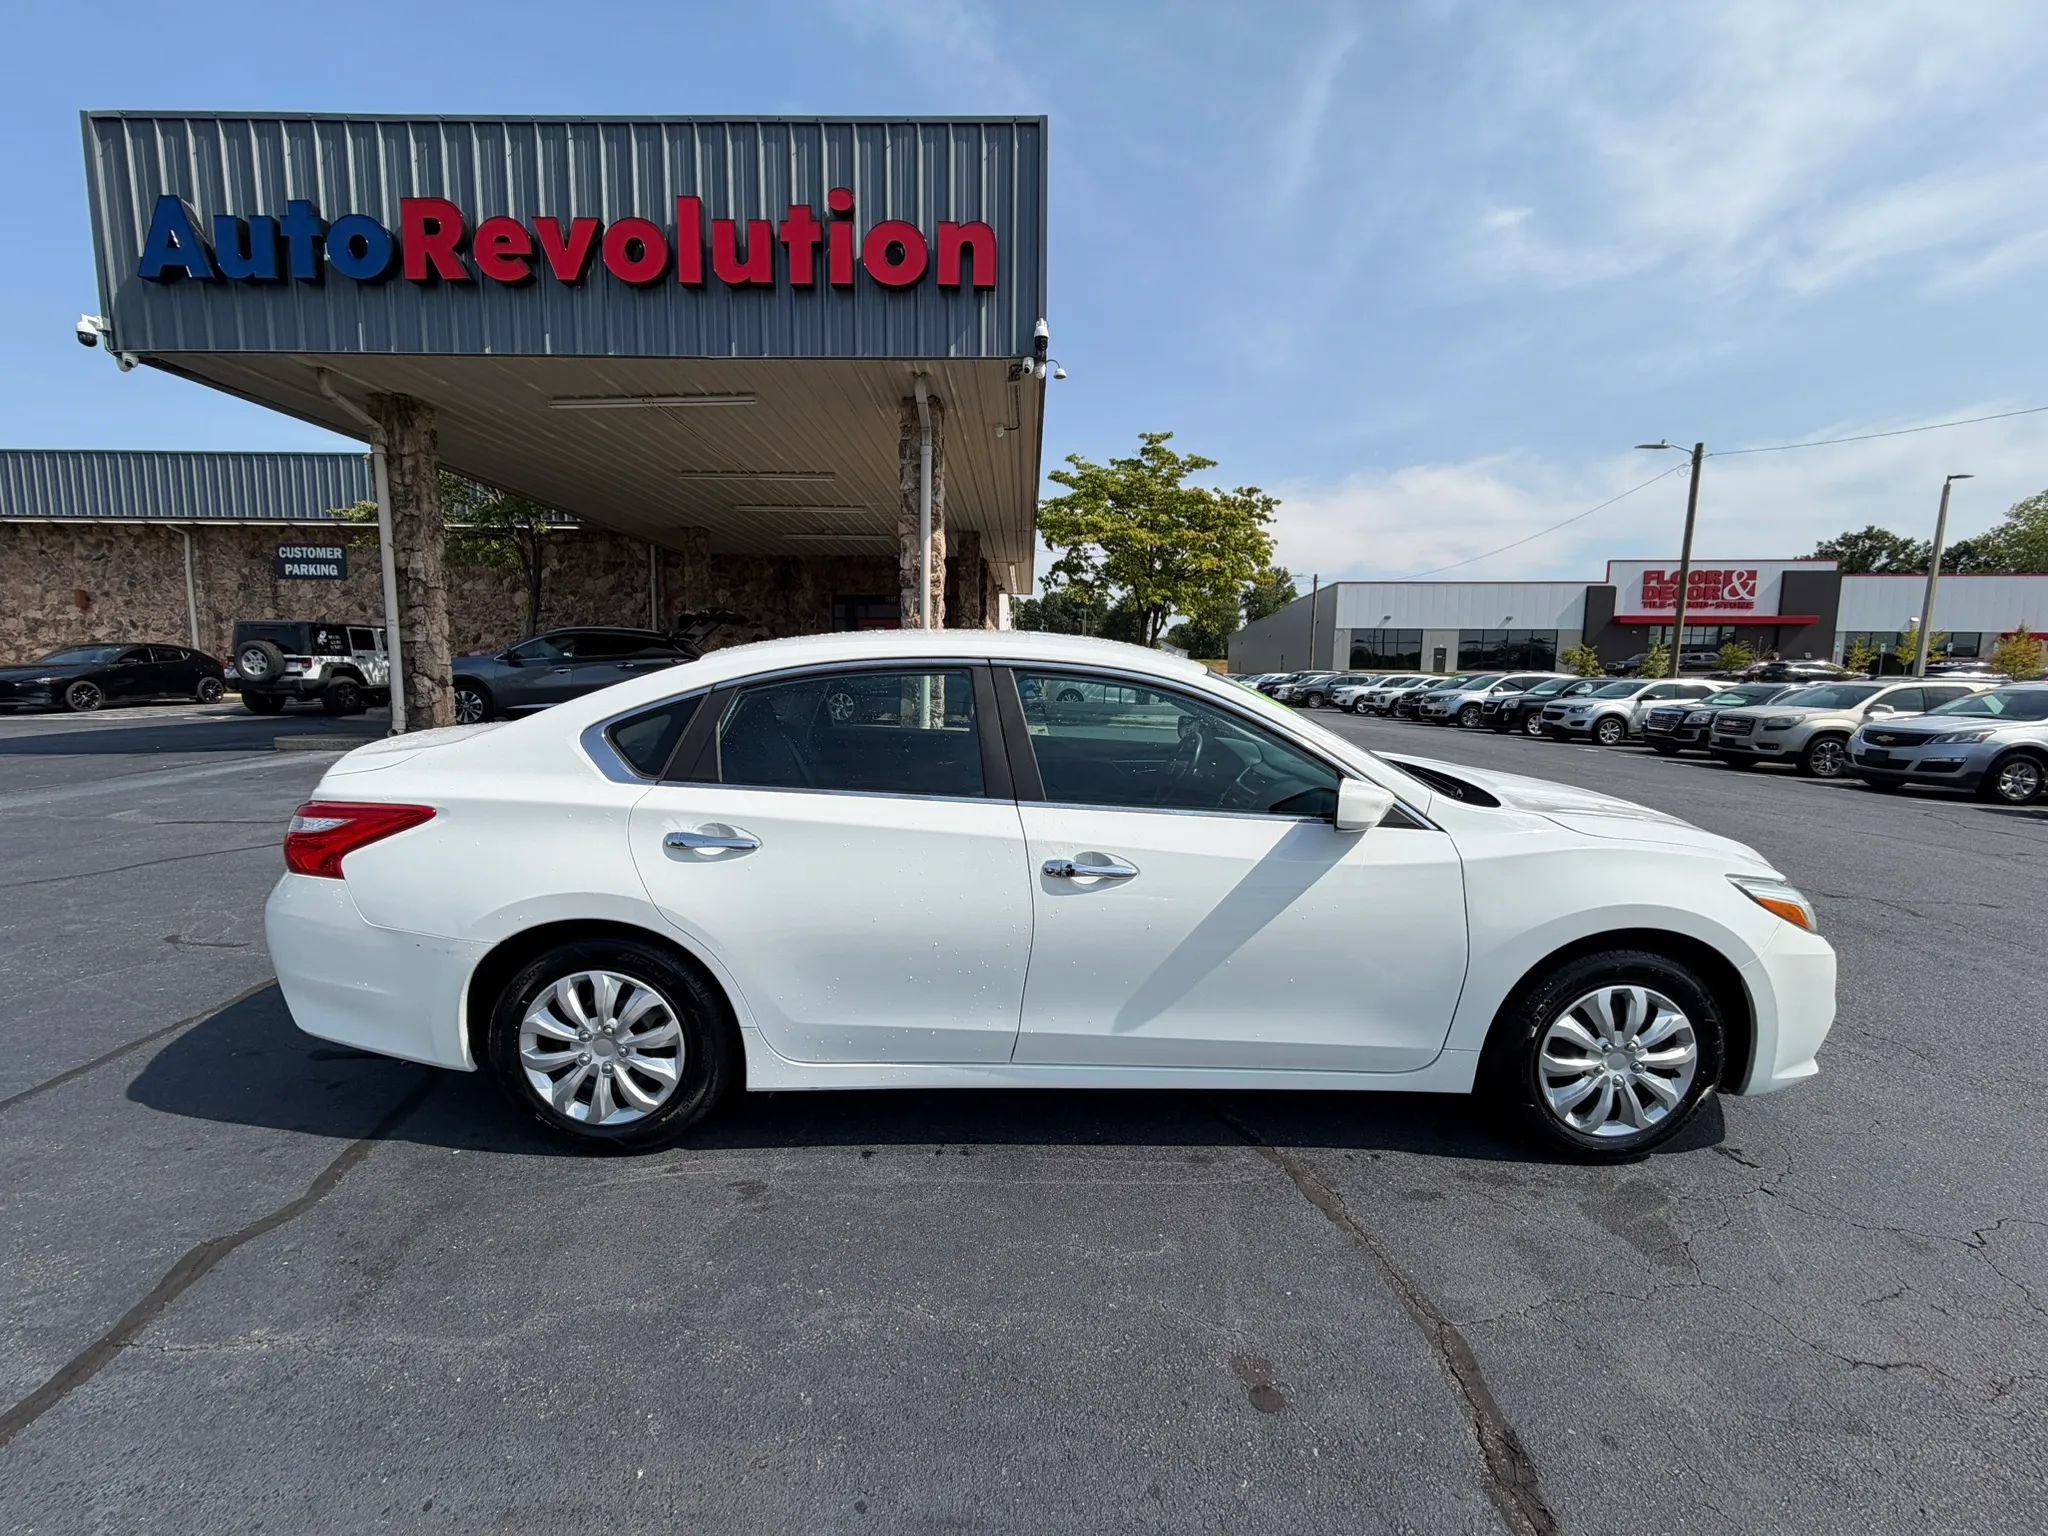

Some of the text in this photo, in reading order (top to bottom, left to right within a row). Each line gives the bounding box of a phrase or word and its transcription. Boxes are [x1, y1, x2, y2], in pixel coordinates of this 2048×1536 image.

[278, 546, 343, 559] CUSTOMER
[284, 563, 339, 576] PARKING
[1643, 569, 1722, 585] FLOOR
[1722, 569, 1757, 600] &
